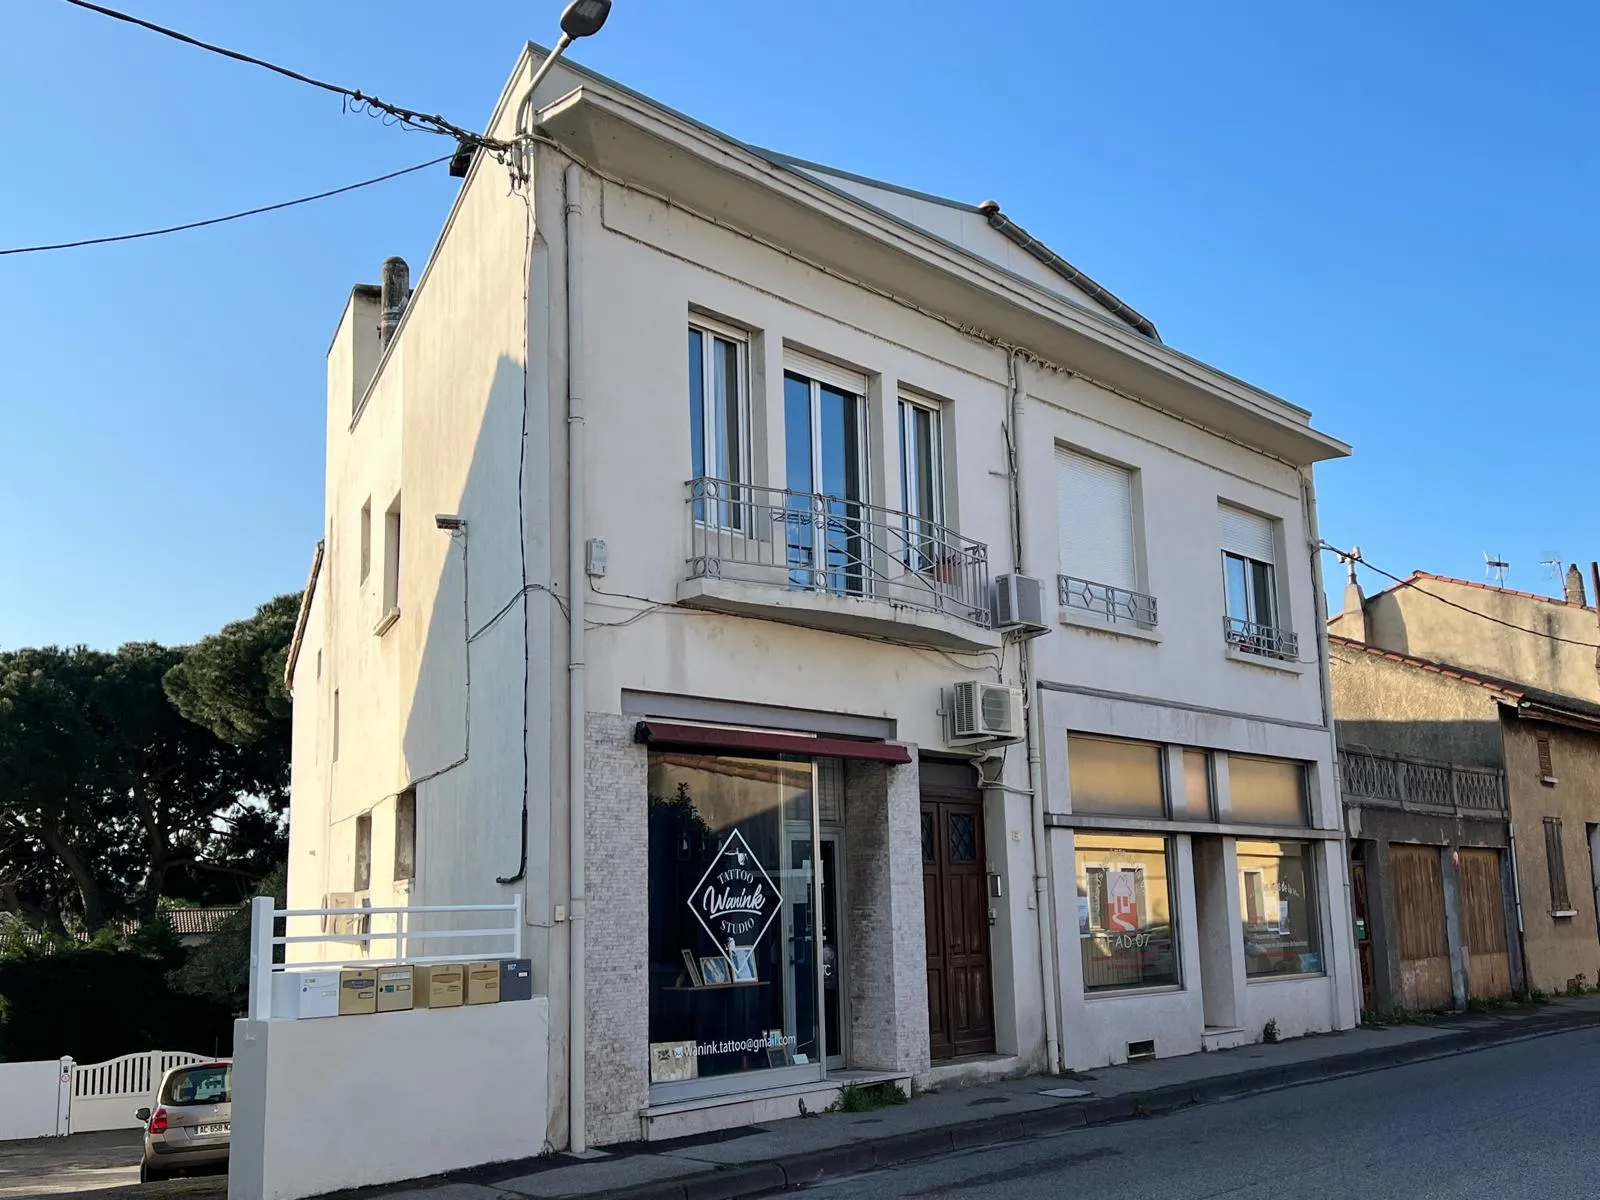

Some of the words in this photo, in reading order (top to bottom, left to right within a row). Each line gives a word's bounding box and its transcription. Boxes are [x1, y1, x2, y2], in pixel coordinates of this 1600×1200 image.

[717, 868, 754, 885] TATTOO
[703, 883, 766, 914] Wanink
[720, 917, 755, 935] STUDIO
[683, 1033, 796, 1058] wanink.tattoo@gmail.com
